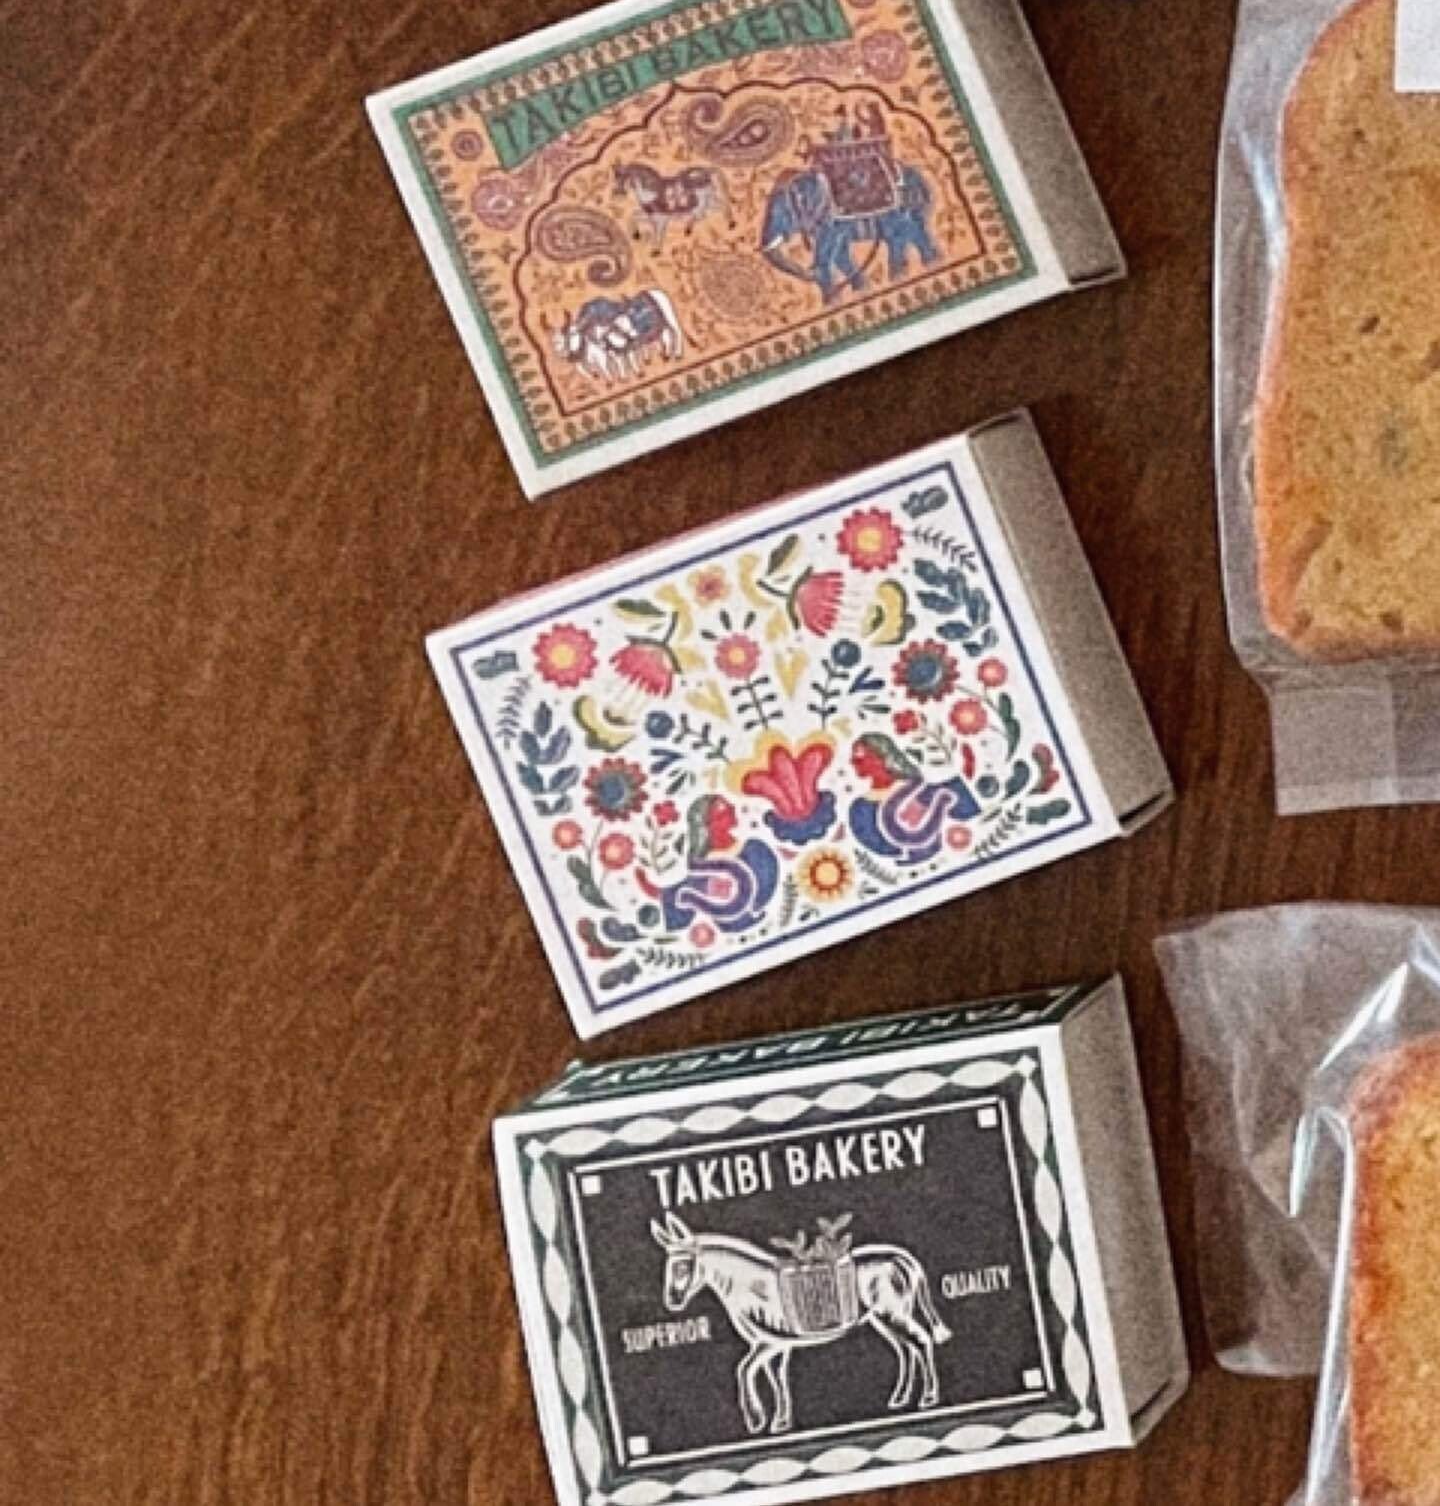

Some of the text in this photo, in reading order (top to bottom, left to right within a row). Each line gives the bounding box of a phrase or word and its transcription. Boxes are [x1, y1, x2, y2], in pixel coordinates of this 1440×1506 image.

[491, 61, 643, 160] TAKIBI
[649, 1124, 926, 1208] TAKIBI BAKERY
[940, 1264, 1013, 1300] QUALITY
[620, 1315, 712, 1354] SUPERIOR
